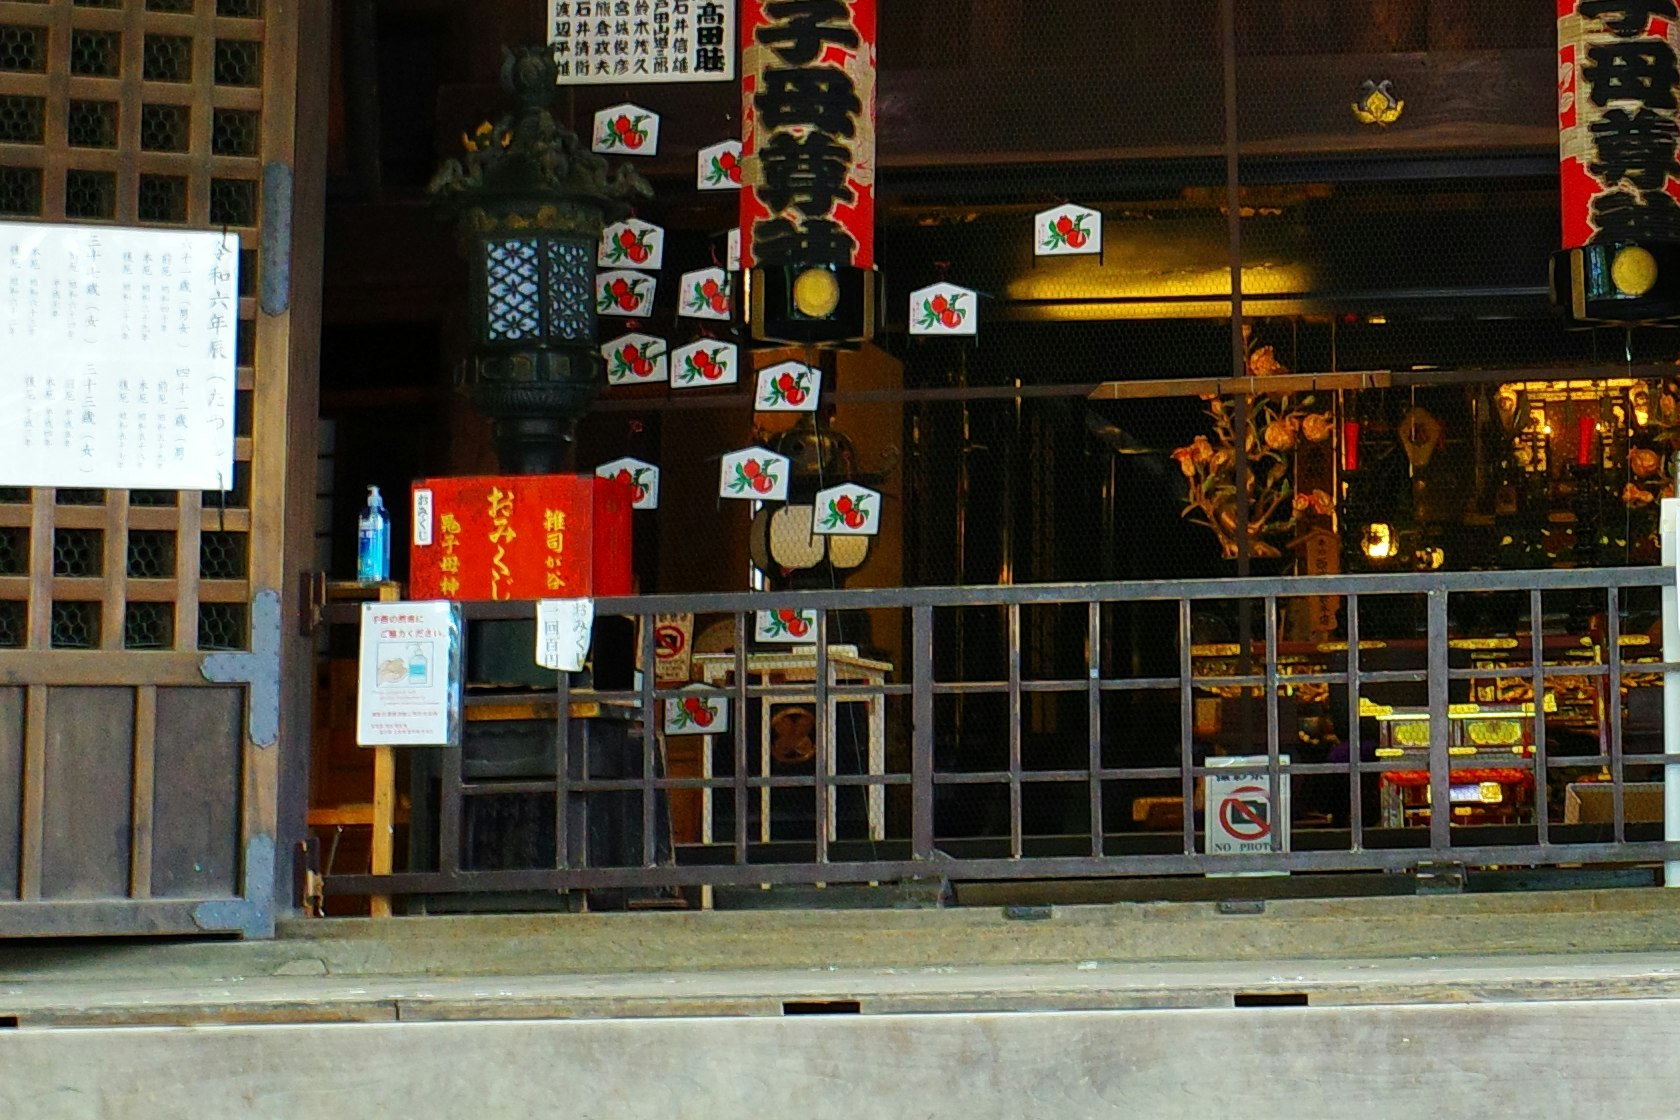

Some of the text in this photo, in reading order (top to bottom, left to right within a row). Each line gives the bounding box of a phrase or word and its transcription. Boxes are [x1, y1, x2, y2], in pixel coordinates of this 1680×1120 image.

[418, 494, 429, 542] おみくじ
[486, 486, 517, 600] おみくじ
[439, 513, 461, 597] 鬼子母神
[1215, 843, 1273, 852] NO PHOT
